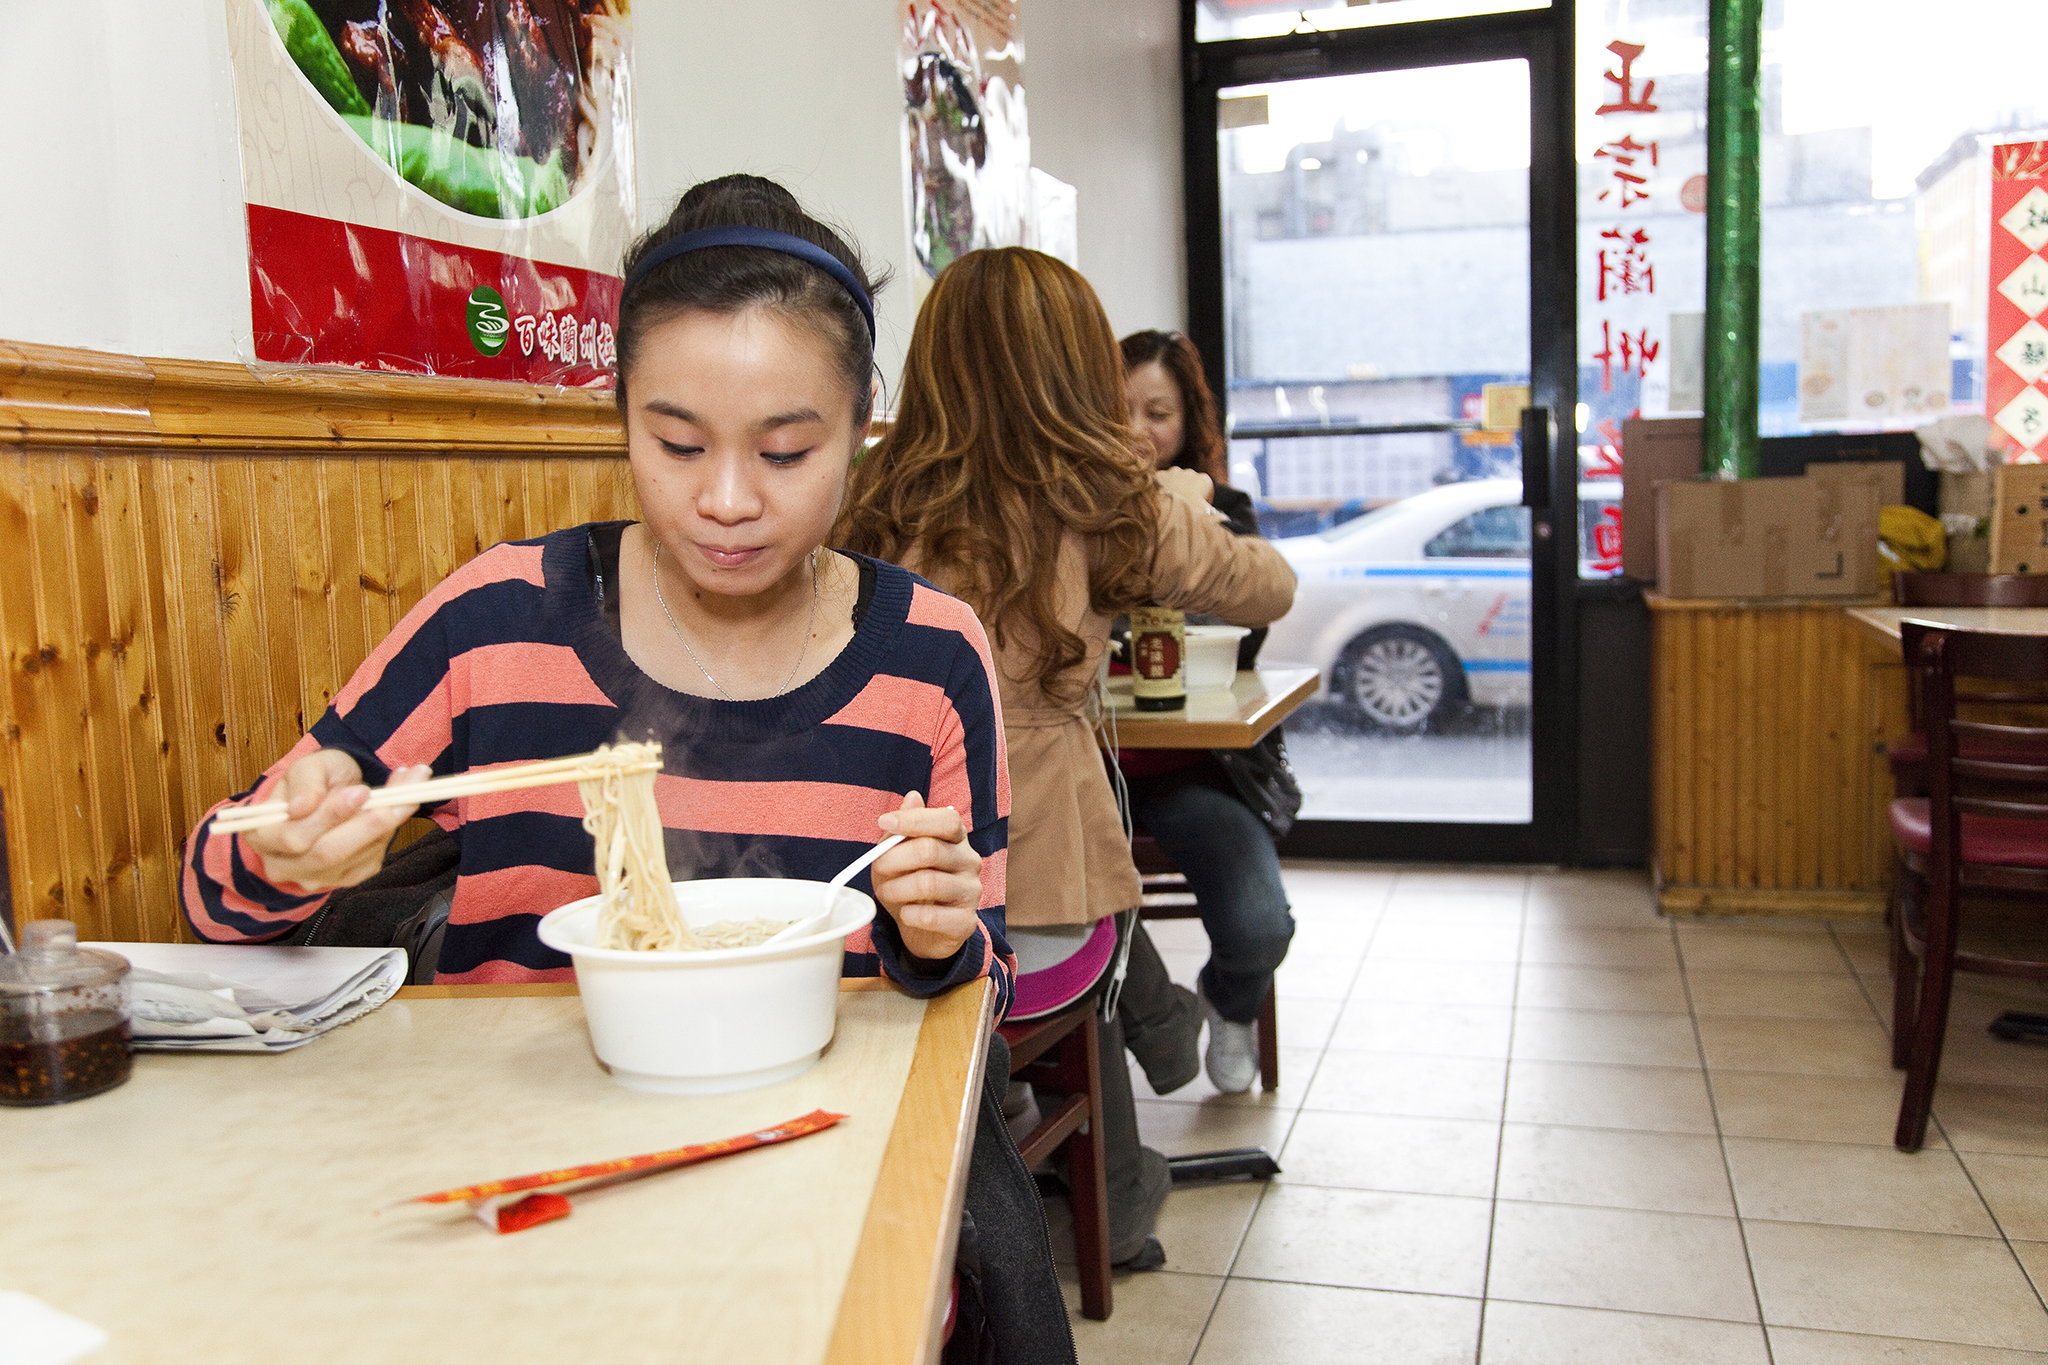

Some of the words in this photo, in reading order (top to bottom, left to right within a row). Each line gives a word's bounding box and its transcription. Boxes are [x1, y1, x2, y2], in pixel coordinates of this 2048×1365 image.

[514, 311, 618, 370] 百味蘭州拉
